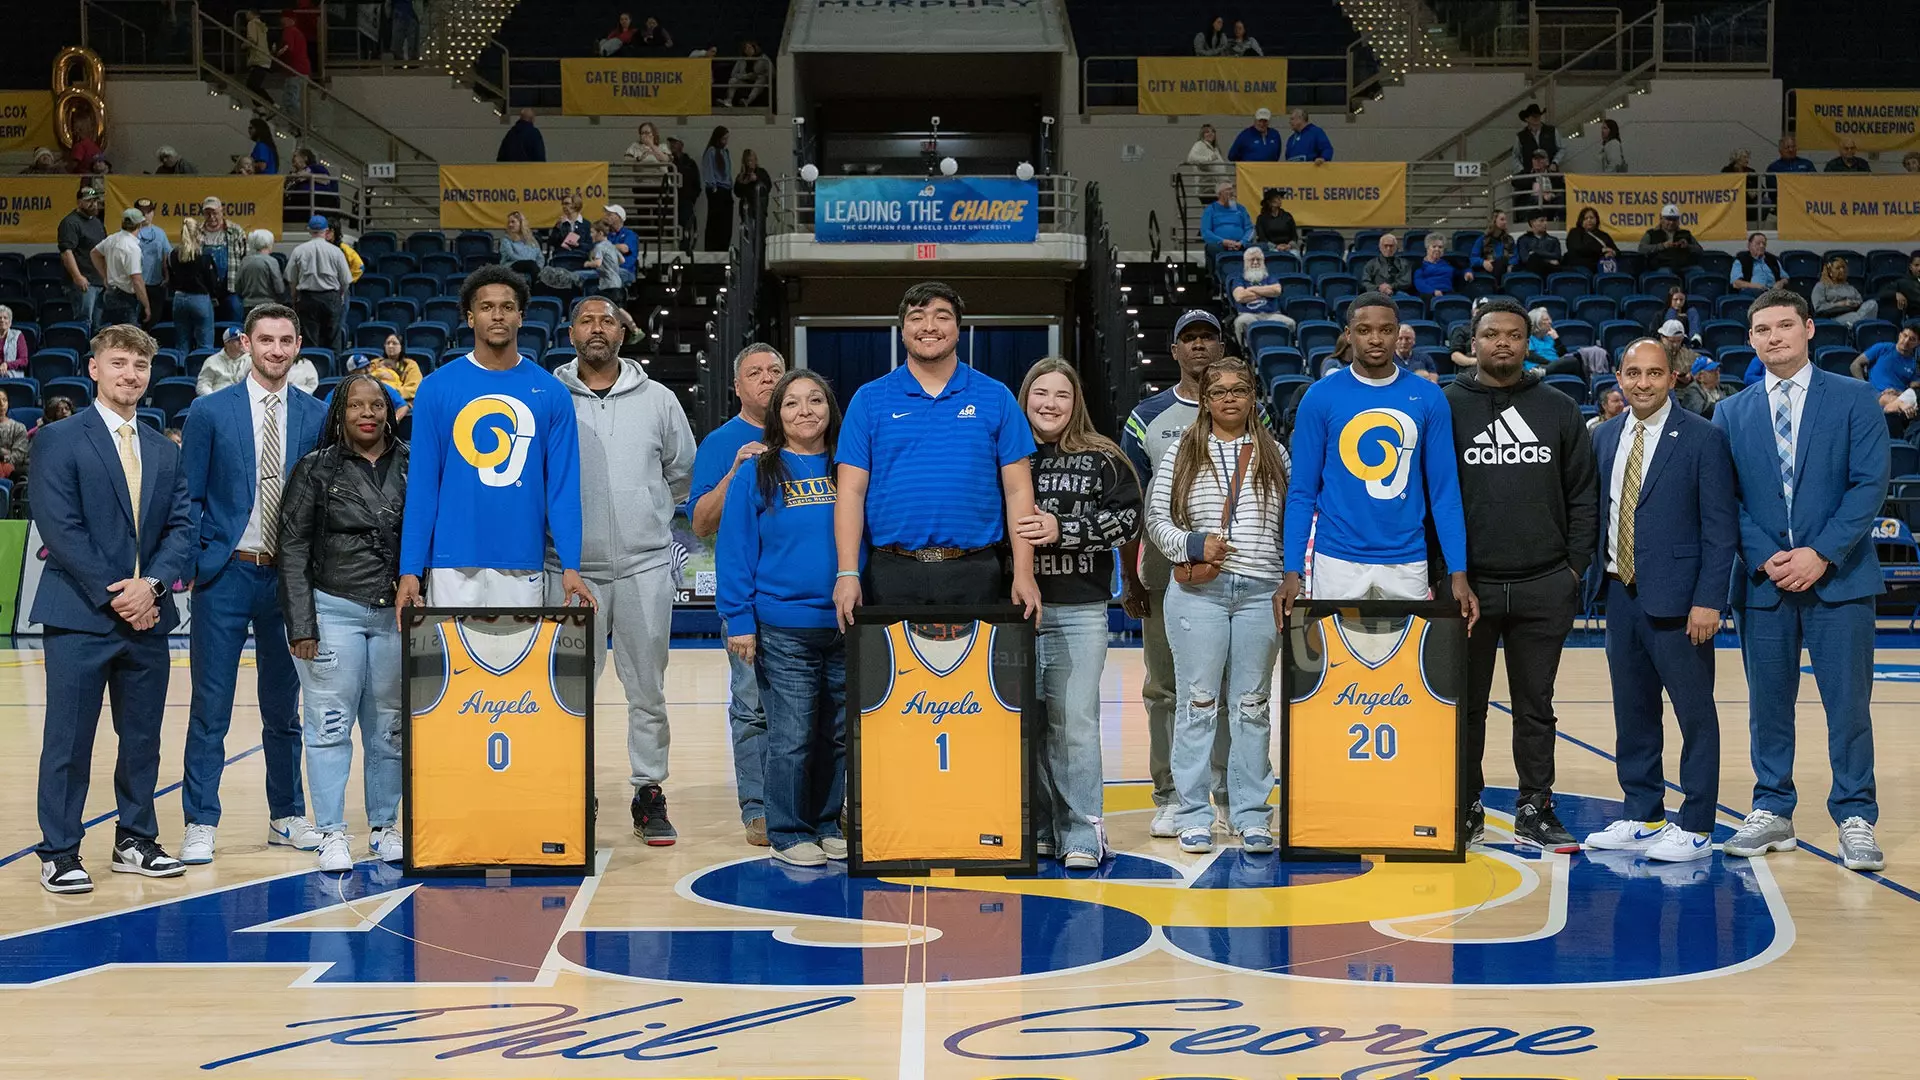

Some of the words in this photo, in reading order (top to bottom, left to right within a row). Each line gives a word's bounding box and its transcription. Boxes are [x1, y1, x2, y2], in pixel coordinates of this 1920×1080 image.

[586, 71, 617, 84] CATE
[622, 72, 683, 84] BOLDRICK
[613, 85, 660, 97] FAMILY
[1148, 79, 1176, 92] CITY
[1180, 79, 1240, 93] NATIONAL
[1244, 81, 1277, 92] BANK
[1814, 105, 1843, 117] PURE
[1835, 121, 1915, 134] BOOKKEEPING
[372, 165, 391, 176] 111
[1457, 163, 1479, 175] 112
[443, 189, 520, 203] ARMSTRONG,
[523, 186, 571, 201] BACKUS
[585, 184, 606, 199] CO.
[1323, 186, 1380, 200] SERVICES
[1573, 188, 1614, 205] TRANS
[1618, 191, 1658, 205] TEXAS
[1661, 188, 1739, 205] SOUTHWEST
[12, 196, 52, 210] MARIA
[162, 203, 169, 217] &
[174, 202, 204, 217] ALEX
[1805, 200, 1836, 215] PAUL
[1840, 201, 1848, 215] &
[1852, 201, 1879, 216] PAM
[824, 200, 901, 223] LEADING
[907, 200, 943, 223] THE
[950, 200, 1029, 222] CHARGE
[1609, 212, 1655, 226] CREDIT
[917, 244, 937, 259] EXIT
[1463, 441, 1552, 465] adidas
[1038, 472, 1092, 495] STATE
[1333, 682, 1412, 715] Angelo
[457, 690, 540, 724] Angelo
[901, 690, 983, 725] Angelo
[1348, 723, 1397, 761] 20
[486, 731, 511, 772] 0
[935, 732, 949, 771] 1
[200, 996, 856, 1071] Phil
[943, 997, 1598, 1080] George
